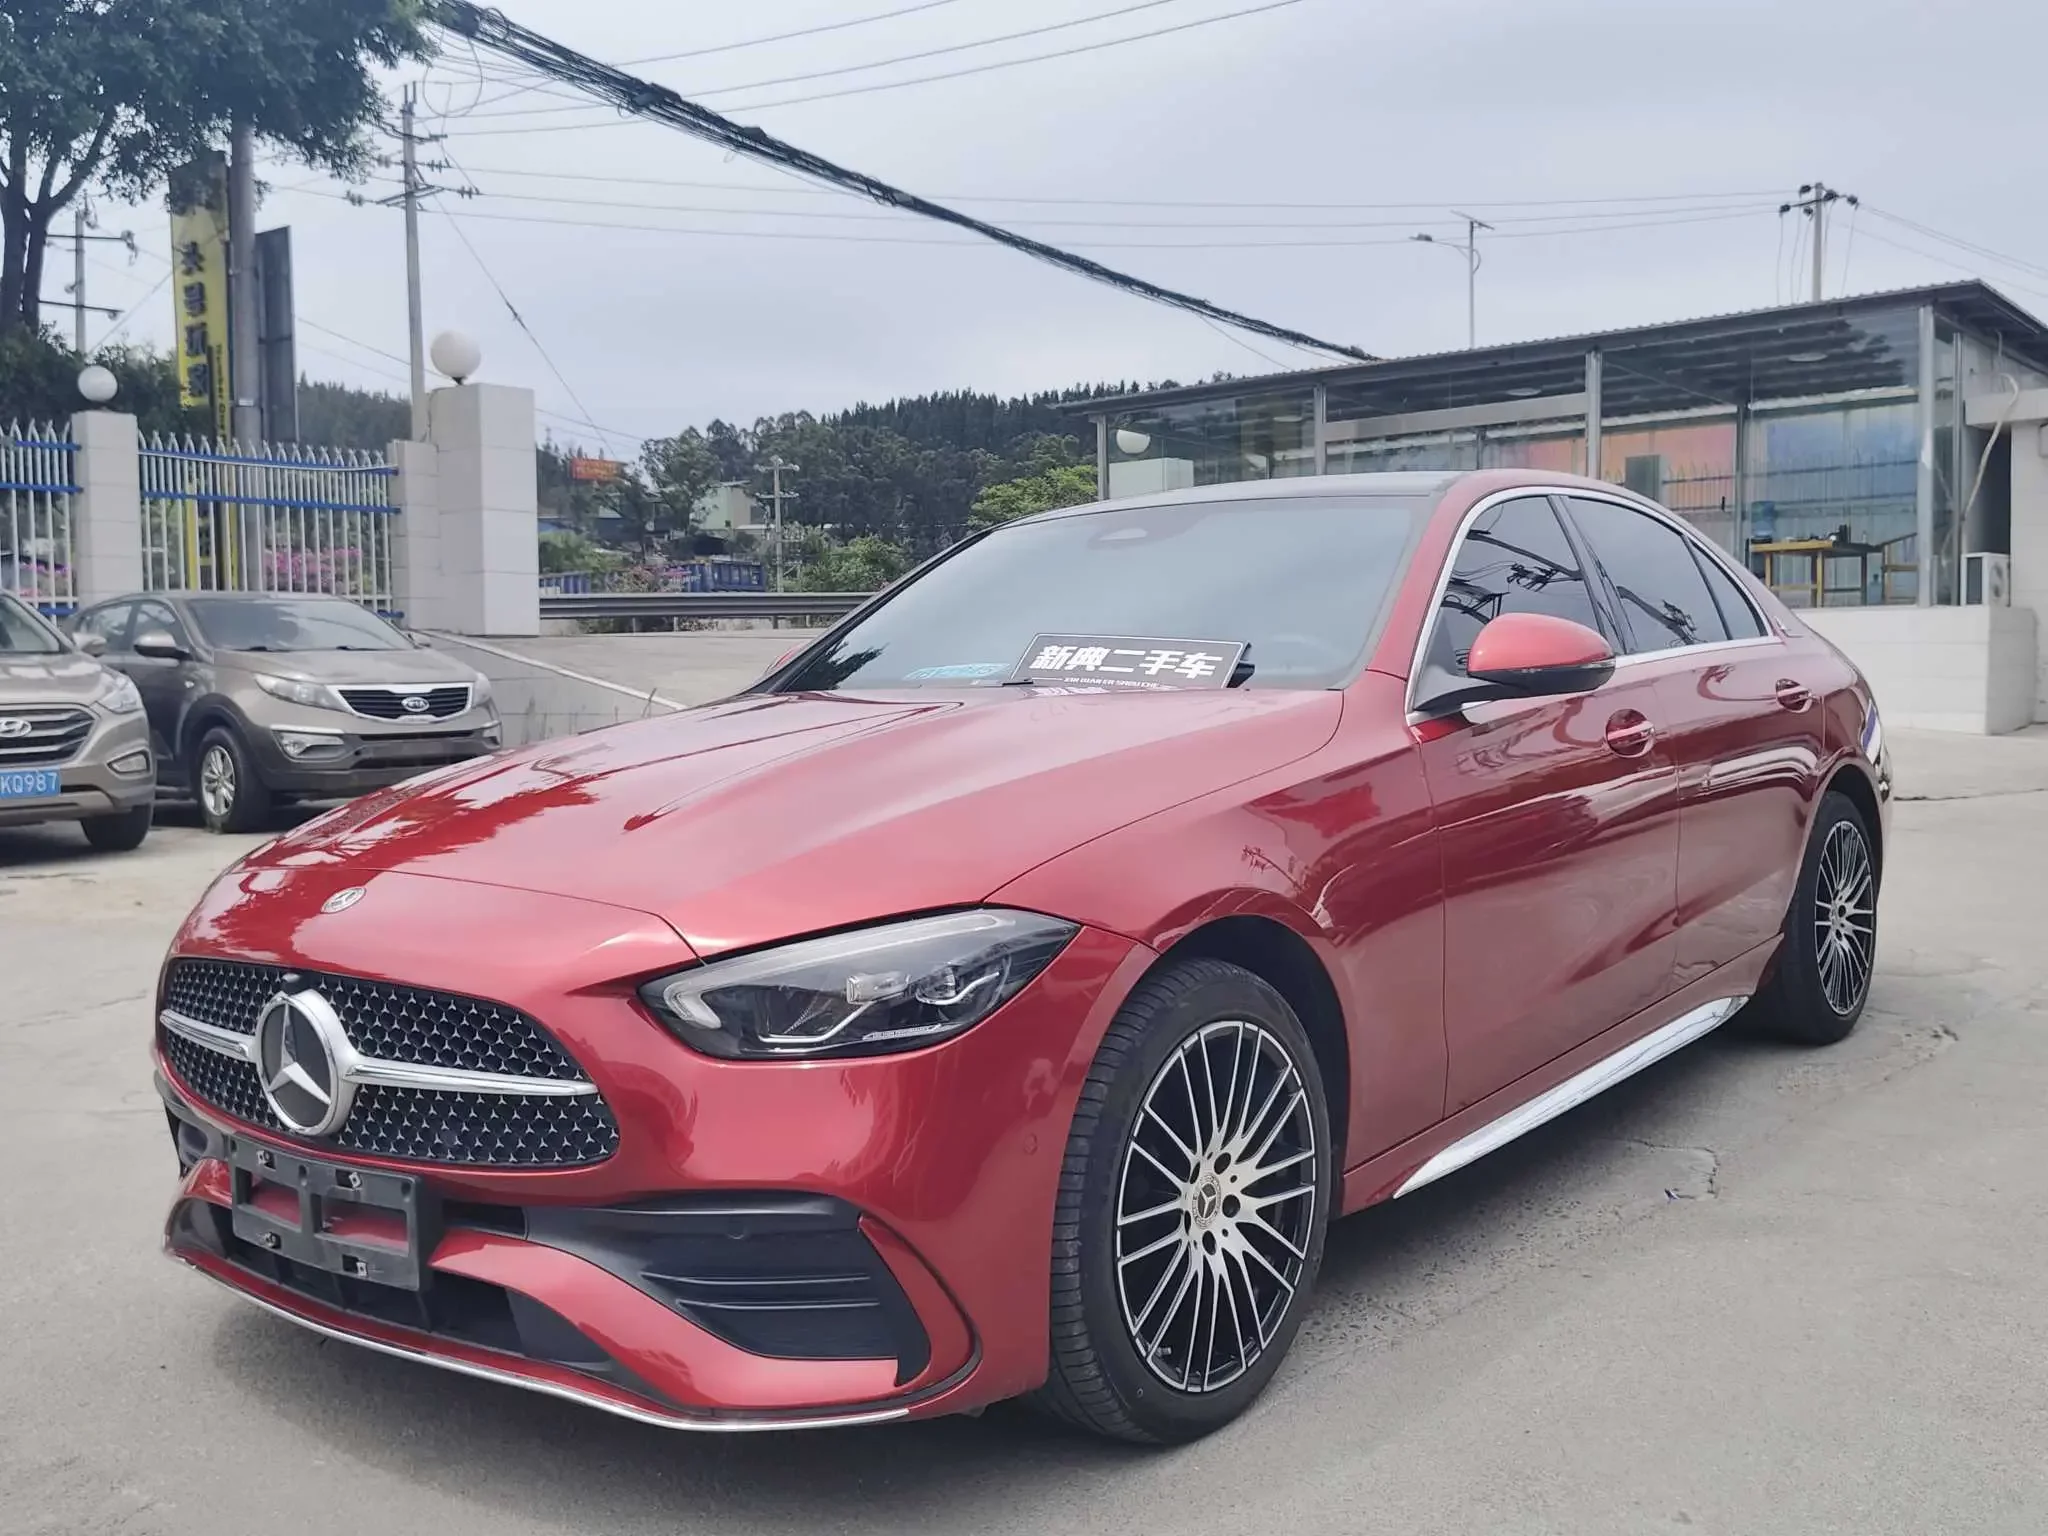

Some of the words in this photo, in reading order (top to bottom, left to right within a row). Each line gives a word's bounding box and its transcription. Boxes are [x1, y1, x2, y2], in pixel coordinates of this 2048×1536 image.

[1029, 645, 1223, 677] 新典二手车
